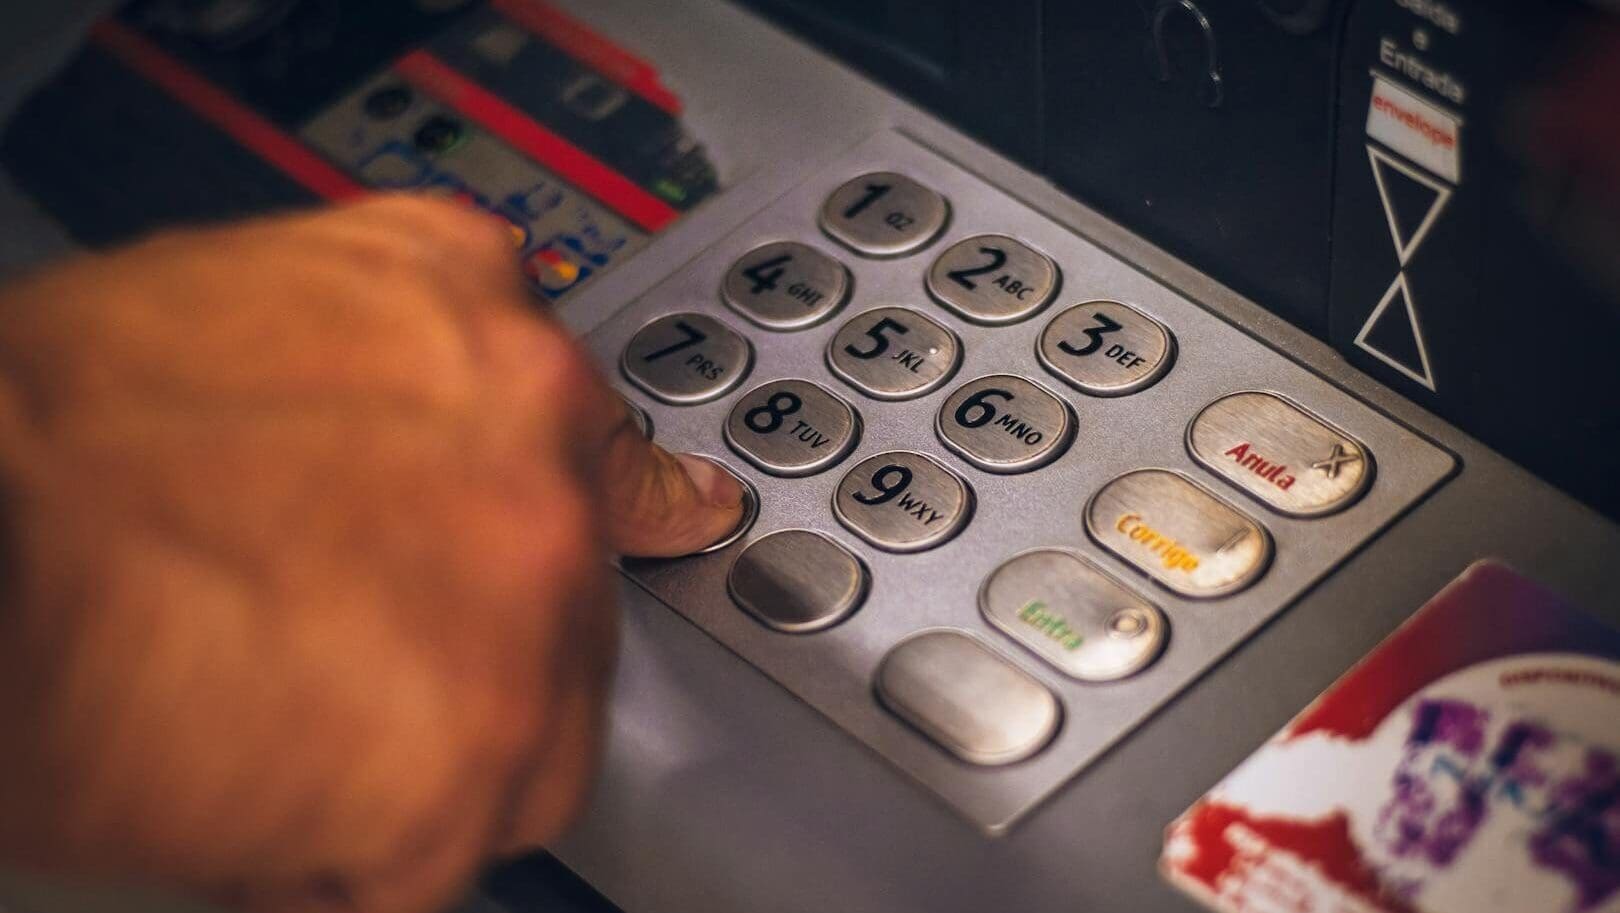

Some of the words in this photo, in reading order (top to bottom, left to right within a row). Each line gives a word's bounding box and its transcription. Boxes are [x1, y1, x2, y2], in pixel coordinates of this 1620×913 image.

[1380, 37, 1465, 105] Entrada
[1371, 94, 1457, 150] envelope
[844, 183, 891, 219] 1
[742, 255, 793, 295] 4
[787, 283, 825, 307] GHI
[947, 247, 1006, 291] 2
[996, 274, 1035, 301] ABC
[645, 321, 702, 363] 7
[685, 352, 724, 382] PRS
[845, 317, 909, 360] 5
[892, 346, 926, 375] JKL
[1057, 311, 1122, 357] 3
[1105, 342, 1147, 370] DEF
[743, 391, 803, 436] 8
[790, 420, 831, 451] TUV
[954, 387, 1015, 430] 6
[994, 412, 1044, 447] MNO
[852, 464, 914, 508] 9
[898, 490, 946, 527] WXY
[1224, 442, 1296, 492] Anula
[1115, 513, 1200, 575] Corrige
[1018, 600, 1084, 650] Entra
